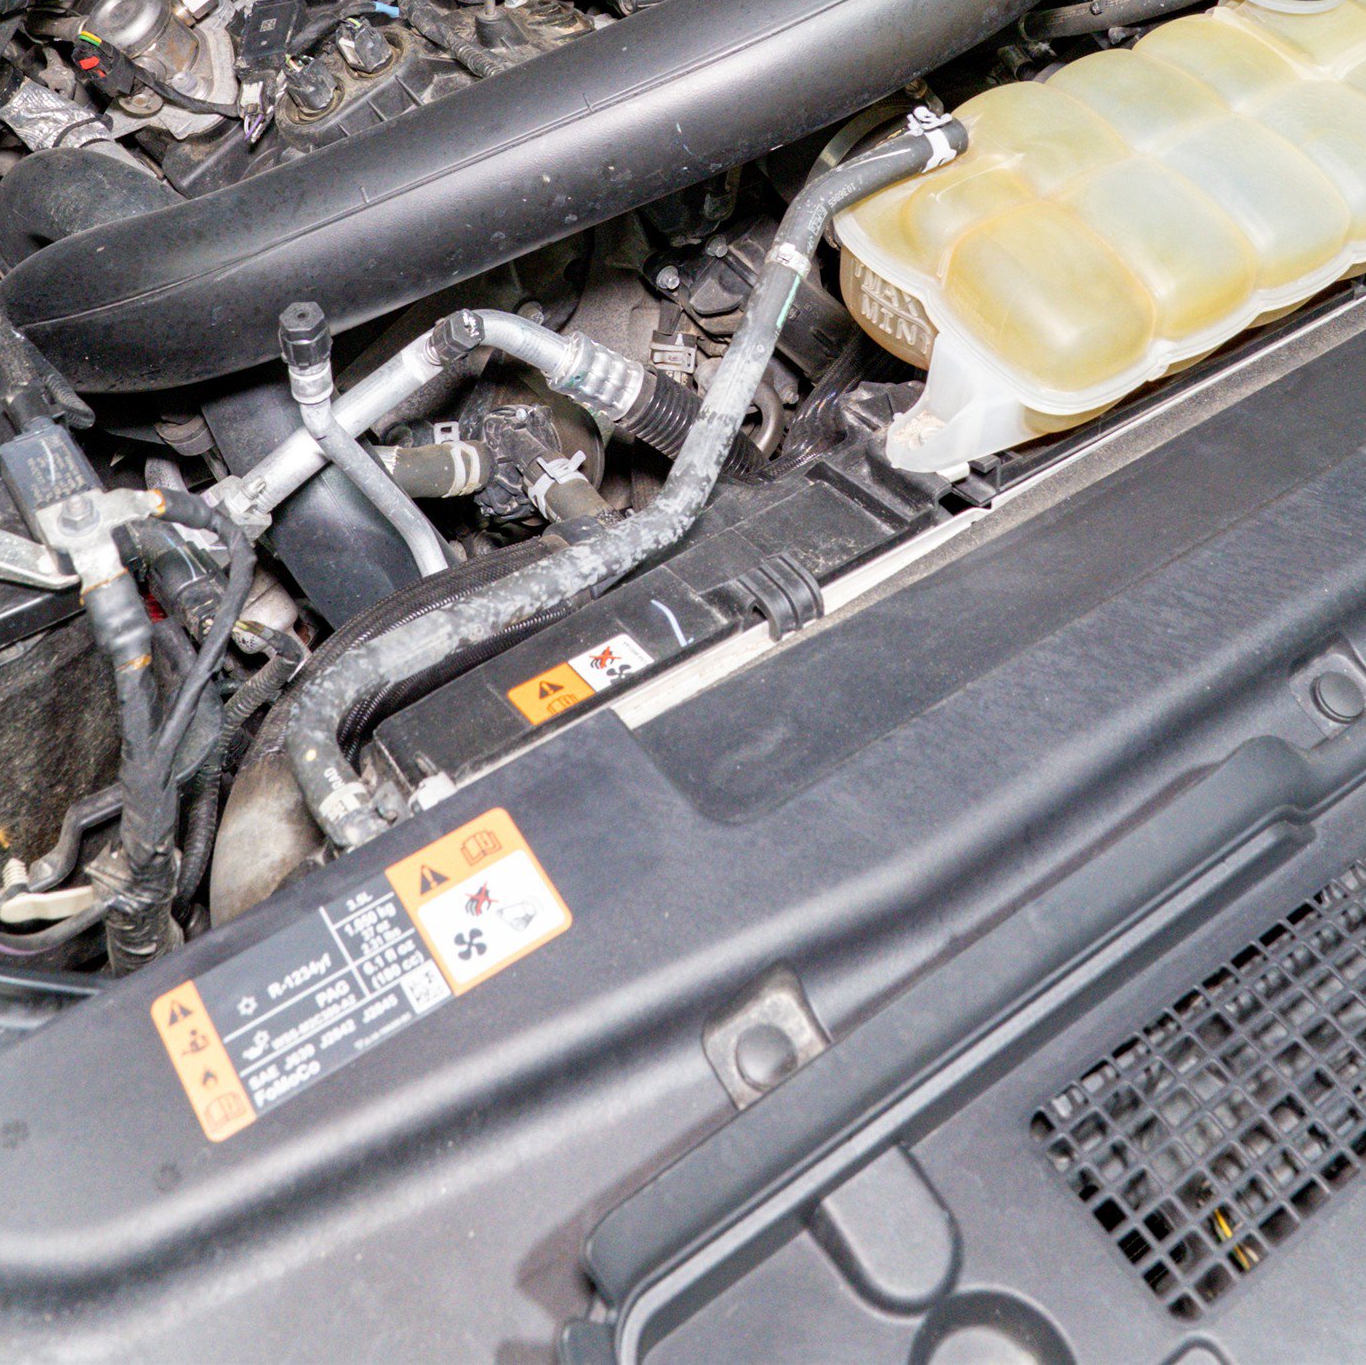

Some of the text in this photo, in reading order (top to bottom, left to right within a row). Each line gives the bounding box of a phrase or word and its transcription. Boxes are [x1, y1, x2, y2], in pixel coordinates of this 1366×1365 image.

[861, 268, 920, 317] MAX
[862, 293, 914, 344] MIN
[267, 953, 331, 999] R-1234yf
[315, 980, 350, 1008] PAG
[253, 1061, 320, 1107] FoMoCo
